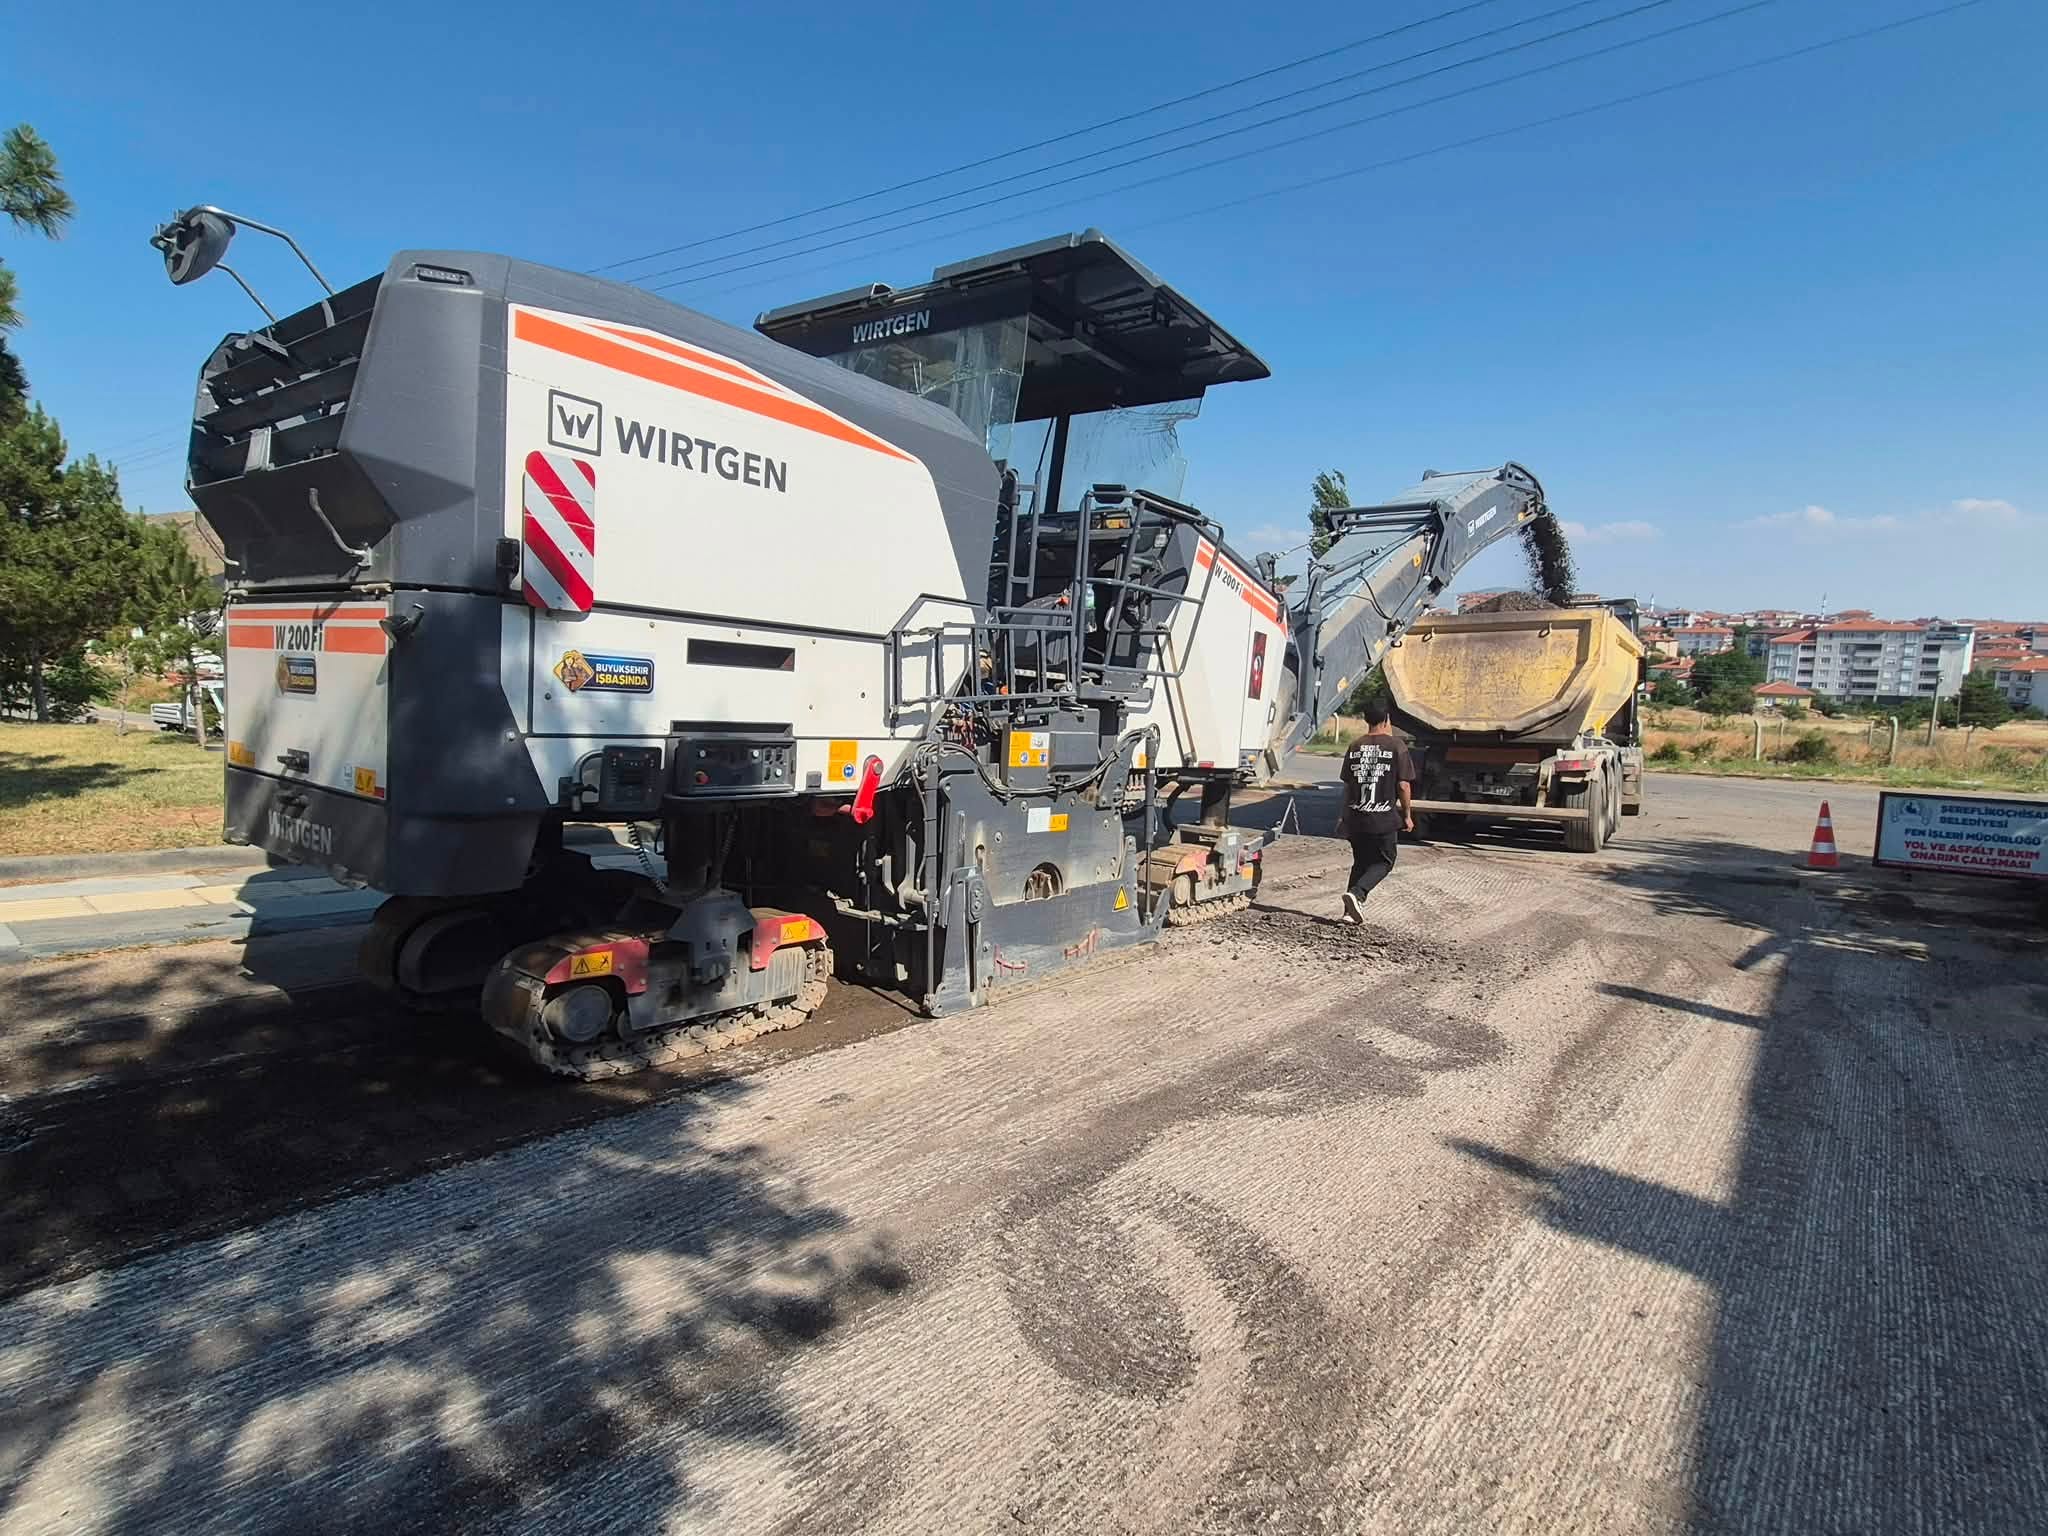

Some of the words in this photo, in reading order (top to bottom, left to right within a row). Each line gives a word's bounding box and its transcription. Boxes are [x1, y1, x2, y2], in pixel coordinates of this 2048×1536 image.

[852, 310, 930, 343] WIRTGEN
[614, 415, 787, 493] WIRTGEN
[275, 625, 286, 650] W
[268, 808, 332, 855] WIRTGEN
[1904, 827, 1928, 837] FEN
[1904, 840, 1928, 850] YOL
[1929, 842, 1946, 852] VE
